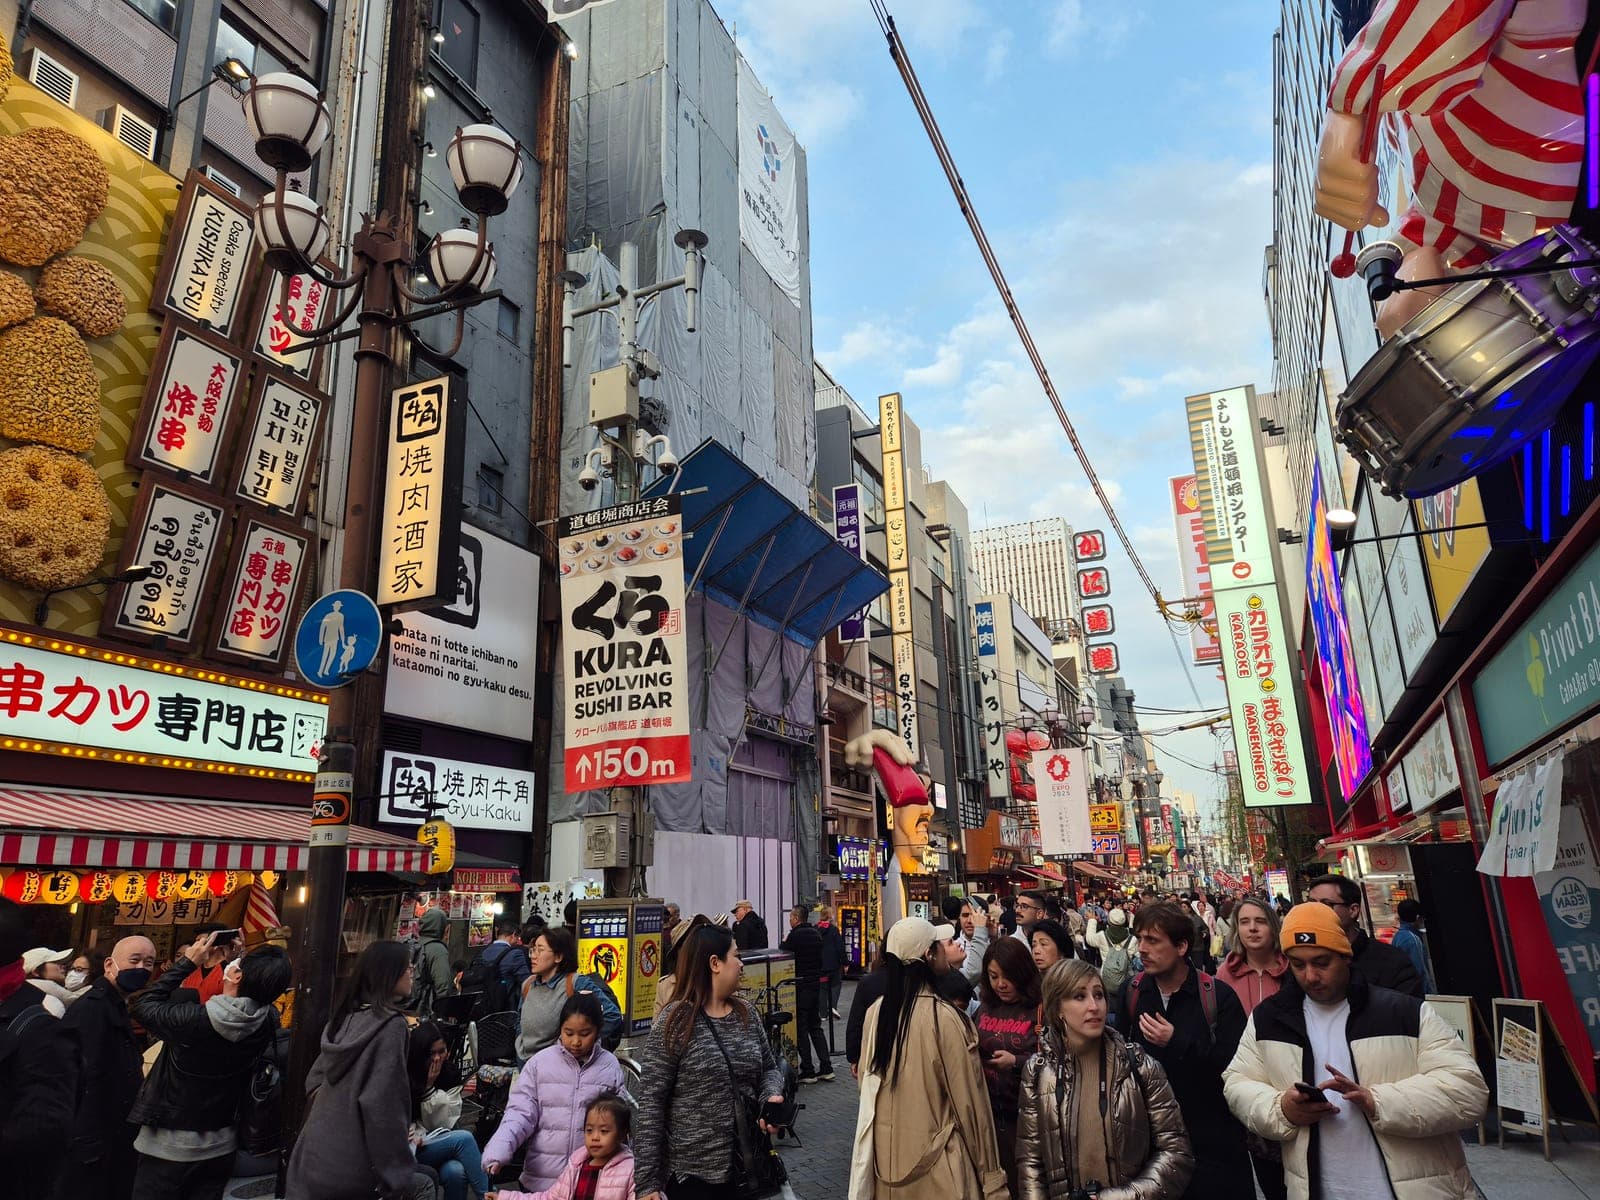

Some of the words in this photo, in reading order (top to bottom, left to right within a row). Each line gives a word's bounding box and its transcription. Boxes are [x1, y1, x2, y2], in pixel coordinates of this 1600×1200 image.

[182, 205, 226, 313] KUSHIKATSU
[228, 220, 244, 257] Osaka
[210, 258, 232, 314] specialty
[157, 381, 198, 452] 炸串
[197, 362, 227, 433] 大阪名物
[264, 398, 291, 444] 꼬치
[289, 399, 311, 446] 오사카
[252, 449, 279, 498] 튀김
[281, 450, 300, 485] 명물
[1204, 423, 1215, 461] YOSHIMOTO
[1217, 506, 1226, 537] THEATER
[1216, 397, 1248, 553] よしもと道頓堀シアター
[391, 444, 434, 595] 焼肉酒家
[569, 497, 669, 530] 道頓堀商店会
[262, 537, 287, 556] 元祖
[229, 551, 269, 638] 専門店
[259, 559, 293, 640] 串カツ
[571, 574, 671, 641] くら
[399, 626, 427, 644] nata
[430, 634, 441, 647] ni
[444, 637, 469, 655] totte
[471, 645, 505, 666] ichiban
[506, 656, 518, 669] no
[976, 610, 995, 648] 焼肉
[1228, 612, 1251, 678] KARAOKE
[1248, 608, 1276, 679] カラオケ
[1540, 604, 1584, 675] Pivot
[392, 653, 444, 678] kataomoi
[447, 668, 460, 682] no
[463, 674, 507, 695] gyu-kaku
[508, 680, 533, 701] desu.
[394, 640, 427, 658] omise
[429, 649, 440, 661] ni
[442, 653, 479, 673] naritai.
[574, 637, 672, 679] KURA
[0, 662, 289, 754] 串カツ専門店
[575, 671, 673, 699] REVOLVING
[575, 694, 622, 720] SUSHI
[627, 691, 673, 712] BAR
[574, 719, 638, 739] グローバル旗艦店
[640, 716, 673, 730] 道頓堀
[981, 668, 1004, 780] いろりや
[1261, 696, 1296, 797] まねきねこ
[594, 745, 676, 781] 150m
[1242, 703, 1269, 793] MANEKINEKO
[442, 767, 530, 804] 焼肉牛角
[1051, 784, 1070, 792] EXPO
[1052, 790, 1071, 798] 2025
[446, 799, 522, 823] Gyu-Kaku
[56, 873, 72, 901] なすび
[456, 871, 482, 884] KOBE
[485, 871, 510, 884] BEEF
